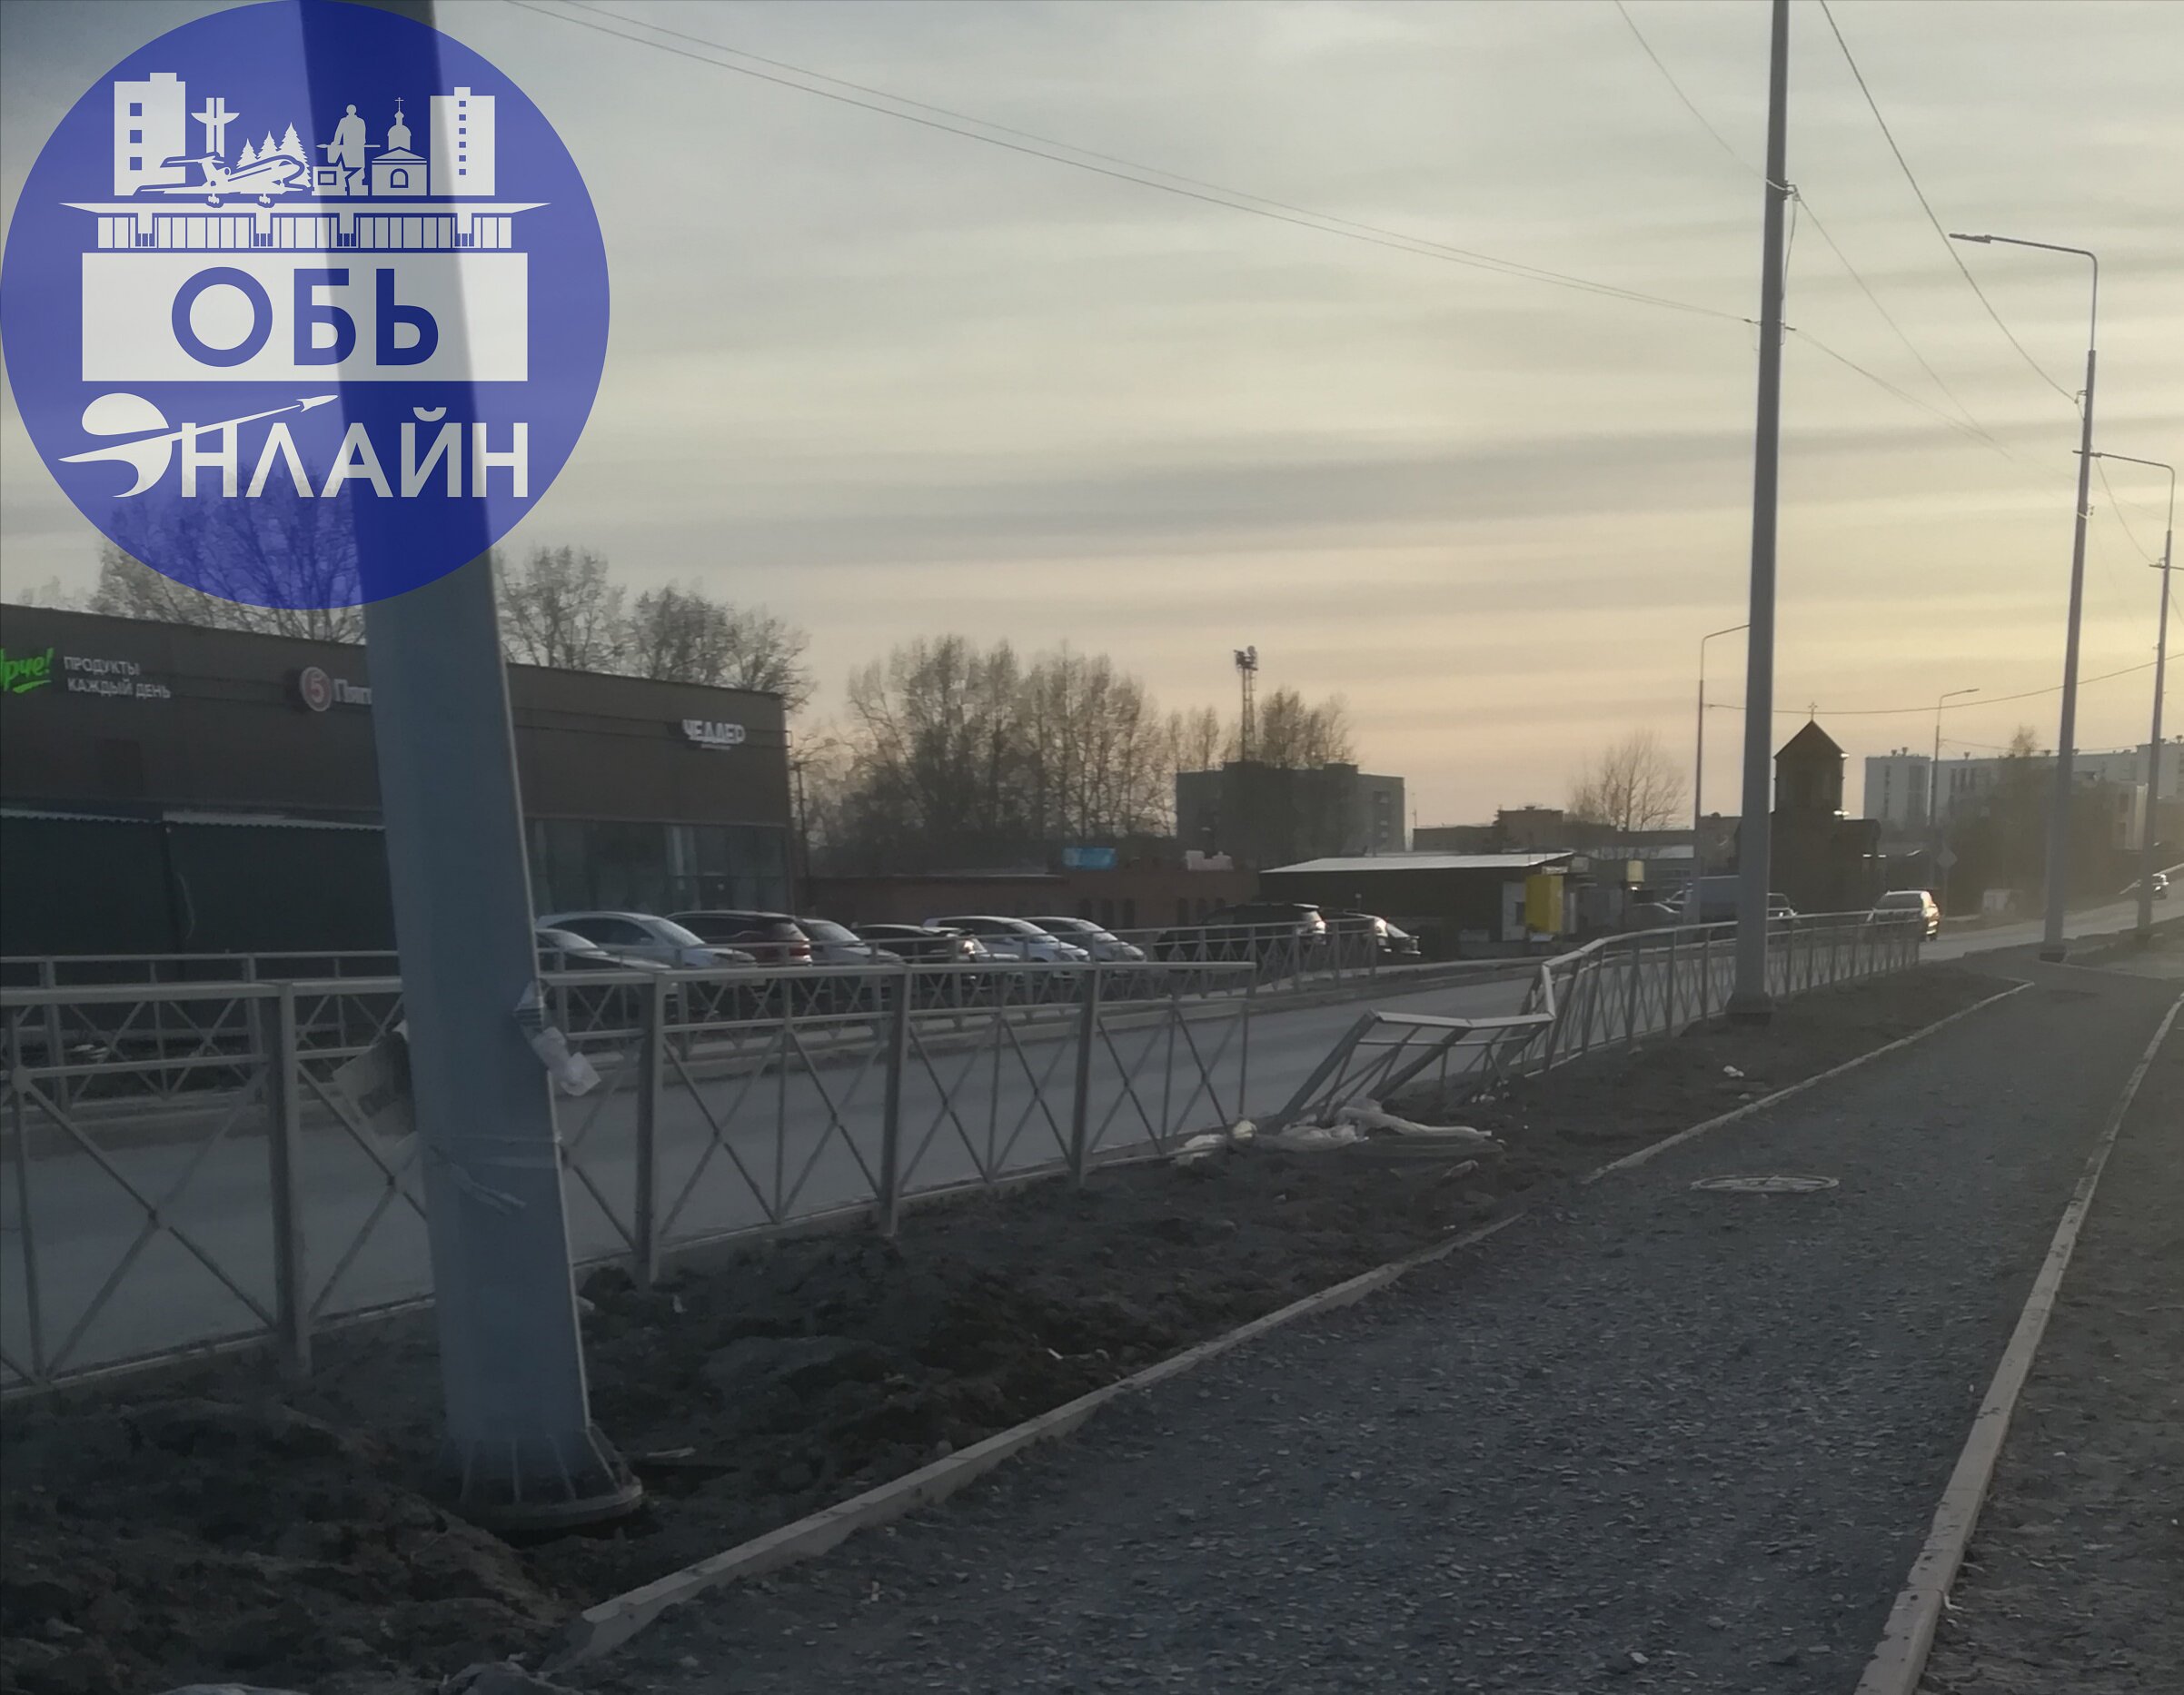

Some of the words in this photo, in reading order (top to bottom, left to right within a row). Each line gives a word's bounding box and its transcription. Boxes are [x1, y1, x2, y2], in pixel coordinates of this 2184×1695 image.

[64, 655, 140, 676] ПРОДУКТЫ
[67, 678, 134, 697] КАЖДЫЙ
[135, 683, 171, 699] ДЕНЬ
